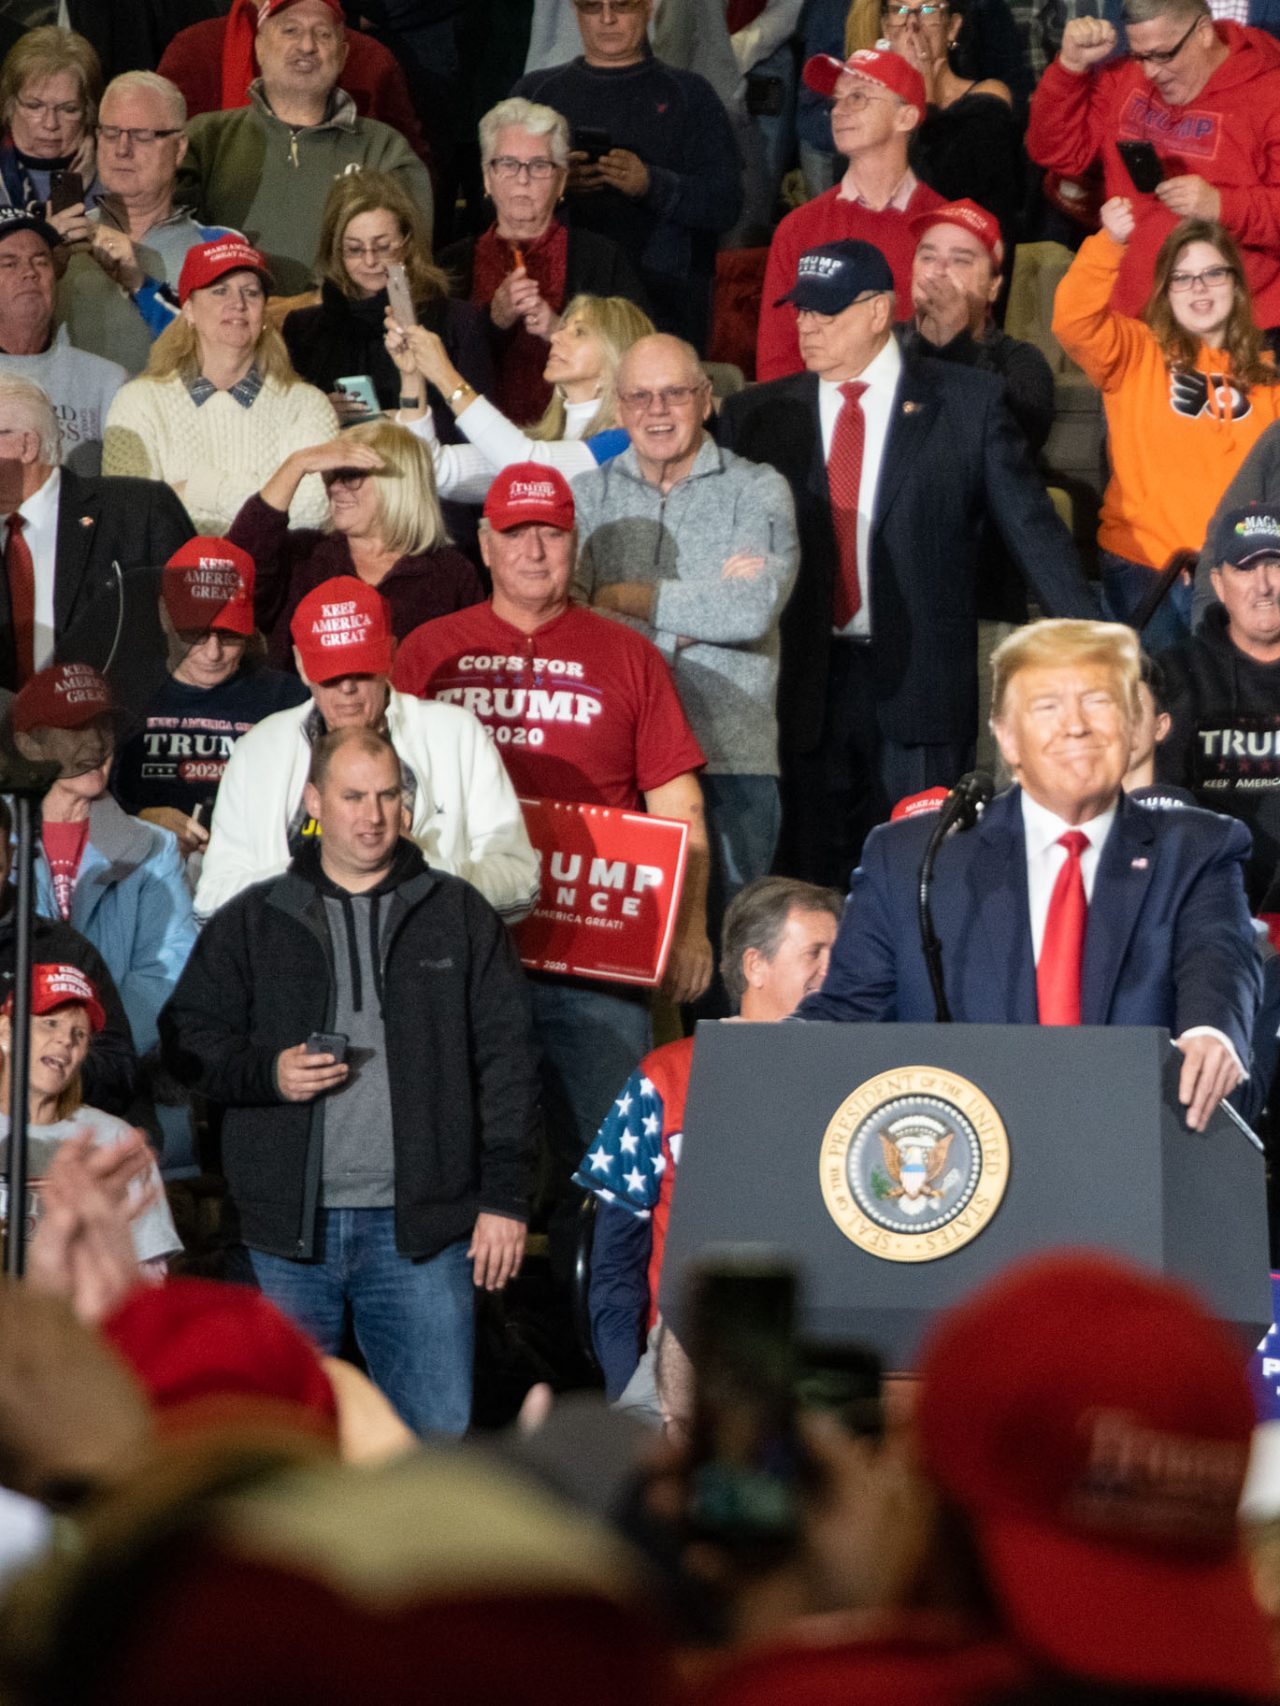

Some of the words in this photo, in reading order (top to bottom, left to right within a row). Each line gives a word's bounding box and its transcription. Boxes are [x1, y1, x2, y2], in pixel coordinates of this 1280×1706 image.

[1245, 515, 1279, 530] MAGA
[199, 556, 234, 571] KEEP
[183, 570, 245, 588] AMERICA
[191, 585, 236, 602] GREAT
[321, 601, 357, 618] KEEP
[311, 613, 373, 634] AMERICA
[320, 629, 367, 647] GREAT
[458, 656, 524, 671] COPS
[532, 657, 584, 679] FOR
[435, 686, 602, 726] TRUMP
[180, 717, 234, 731] AMERICA
[1203, 778, 1229, 789] KEEP
[550, 851, 664, 893] UMP
[556, 886, 641, 917] NCE
[585, 915, 624, 932] GREAT!
[543, 961, 568, 973] 2020
[920, 1076, 935, 1088] OF
[939, 1081, 963, 1098] THE
[828, 1073, 914, 1158] PRESIDENT
[966, 1099, 1002, 1176] UNITED
[829, 1164, 842, 1191] THE
[836, 1196, 849, 1211] OF
[925, 1193, 990, 1250] STATES
[848, 1219, 892, 1250] SEAL
